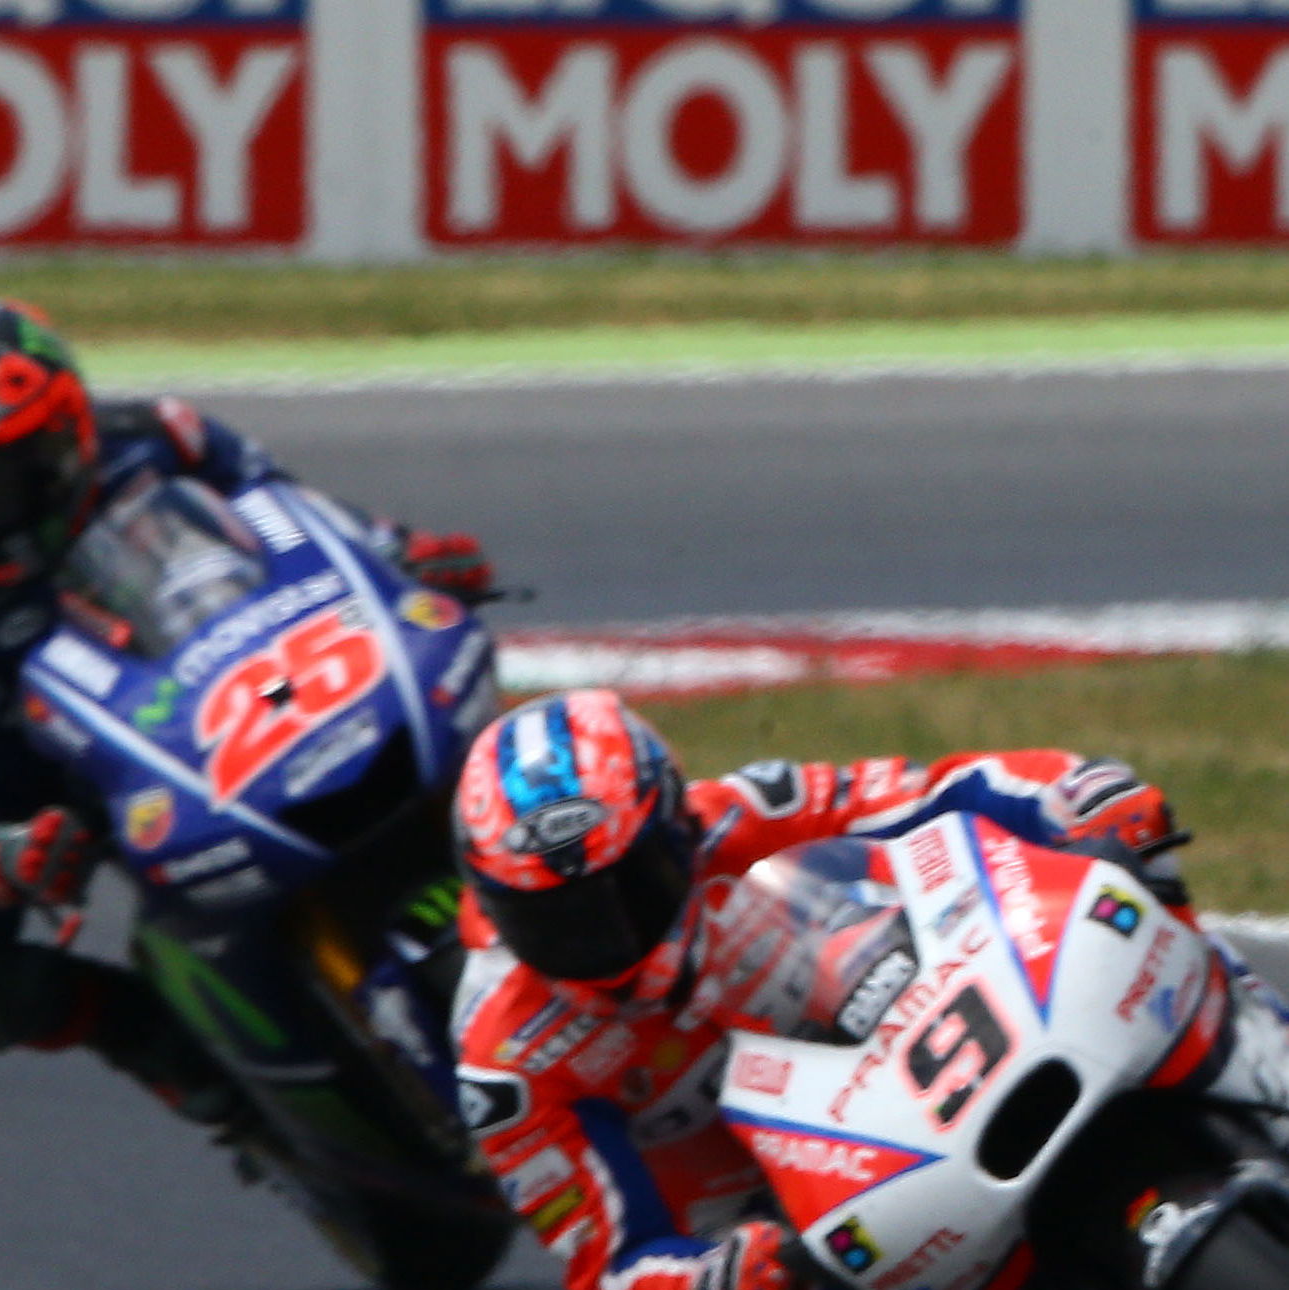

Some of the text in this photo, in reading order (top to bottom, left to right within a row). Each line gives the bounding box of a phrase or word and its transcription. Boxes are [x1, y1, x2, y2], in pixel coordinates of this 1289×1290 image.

[444, 36, 1016, 234] MOLY
[197, 608, 389, 808] 25
[898, 970, 1022, 1132] 9
